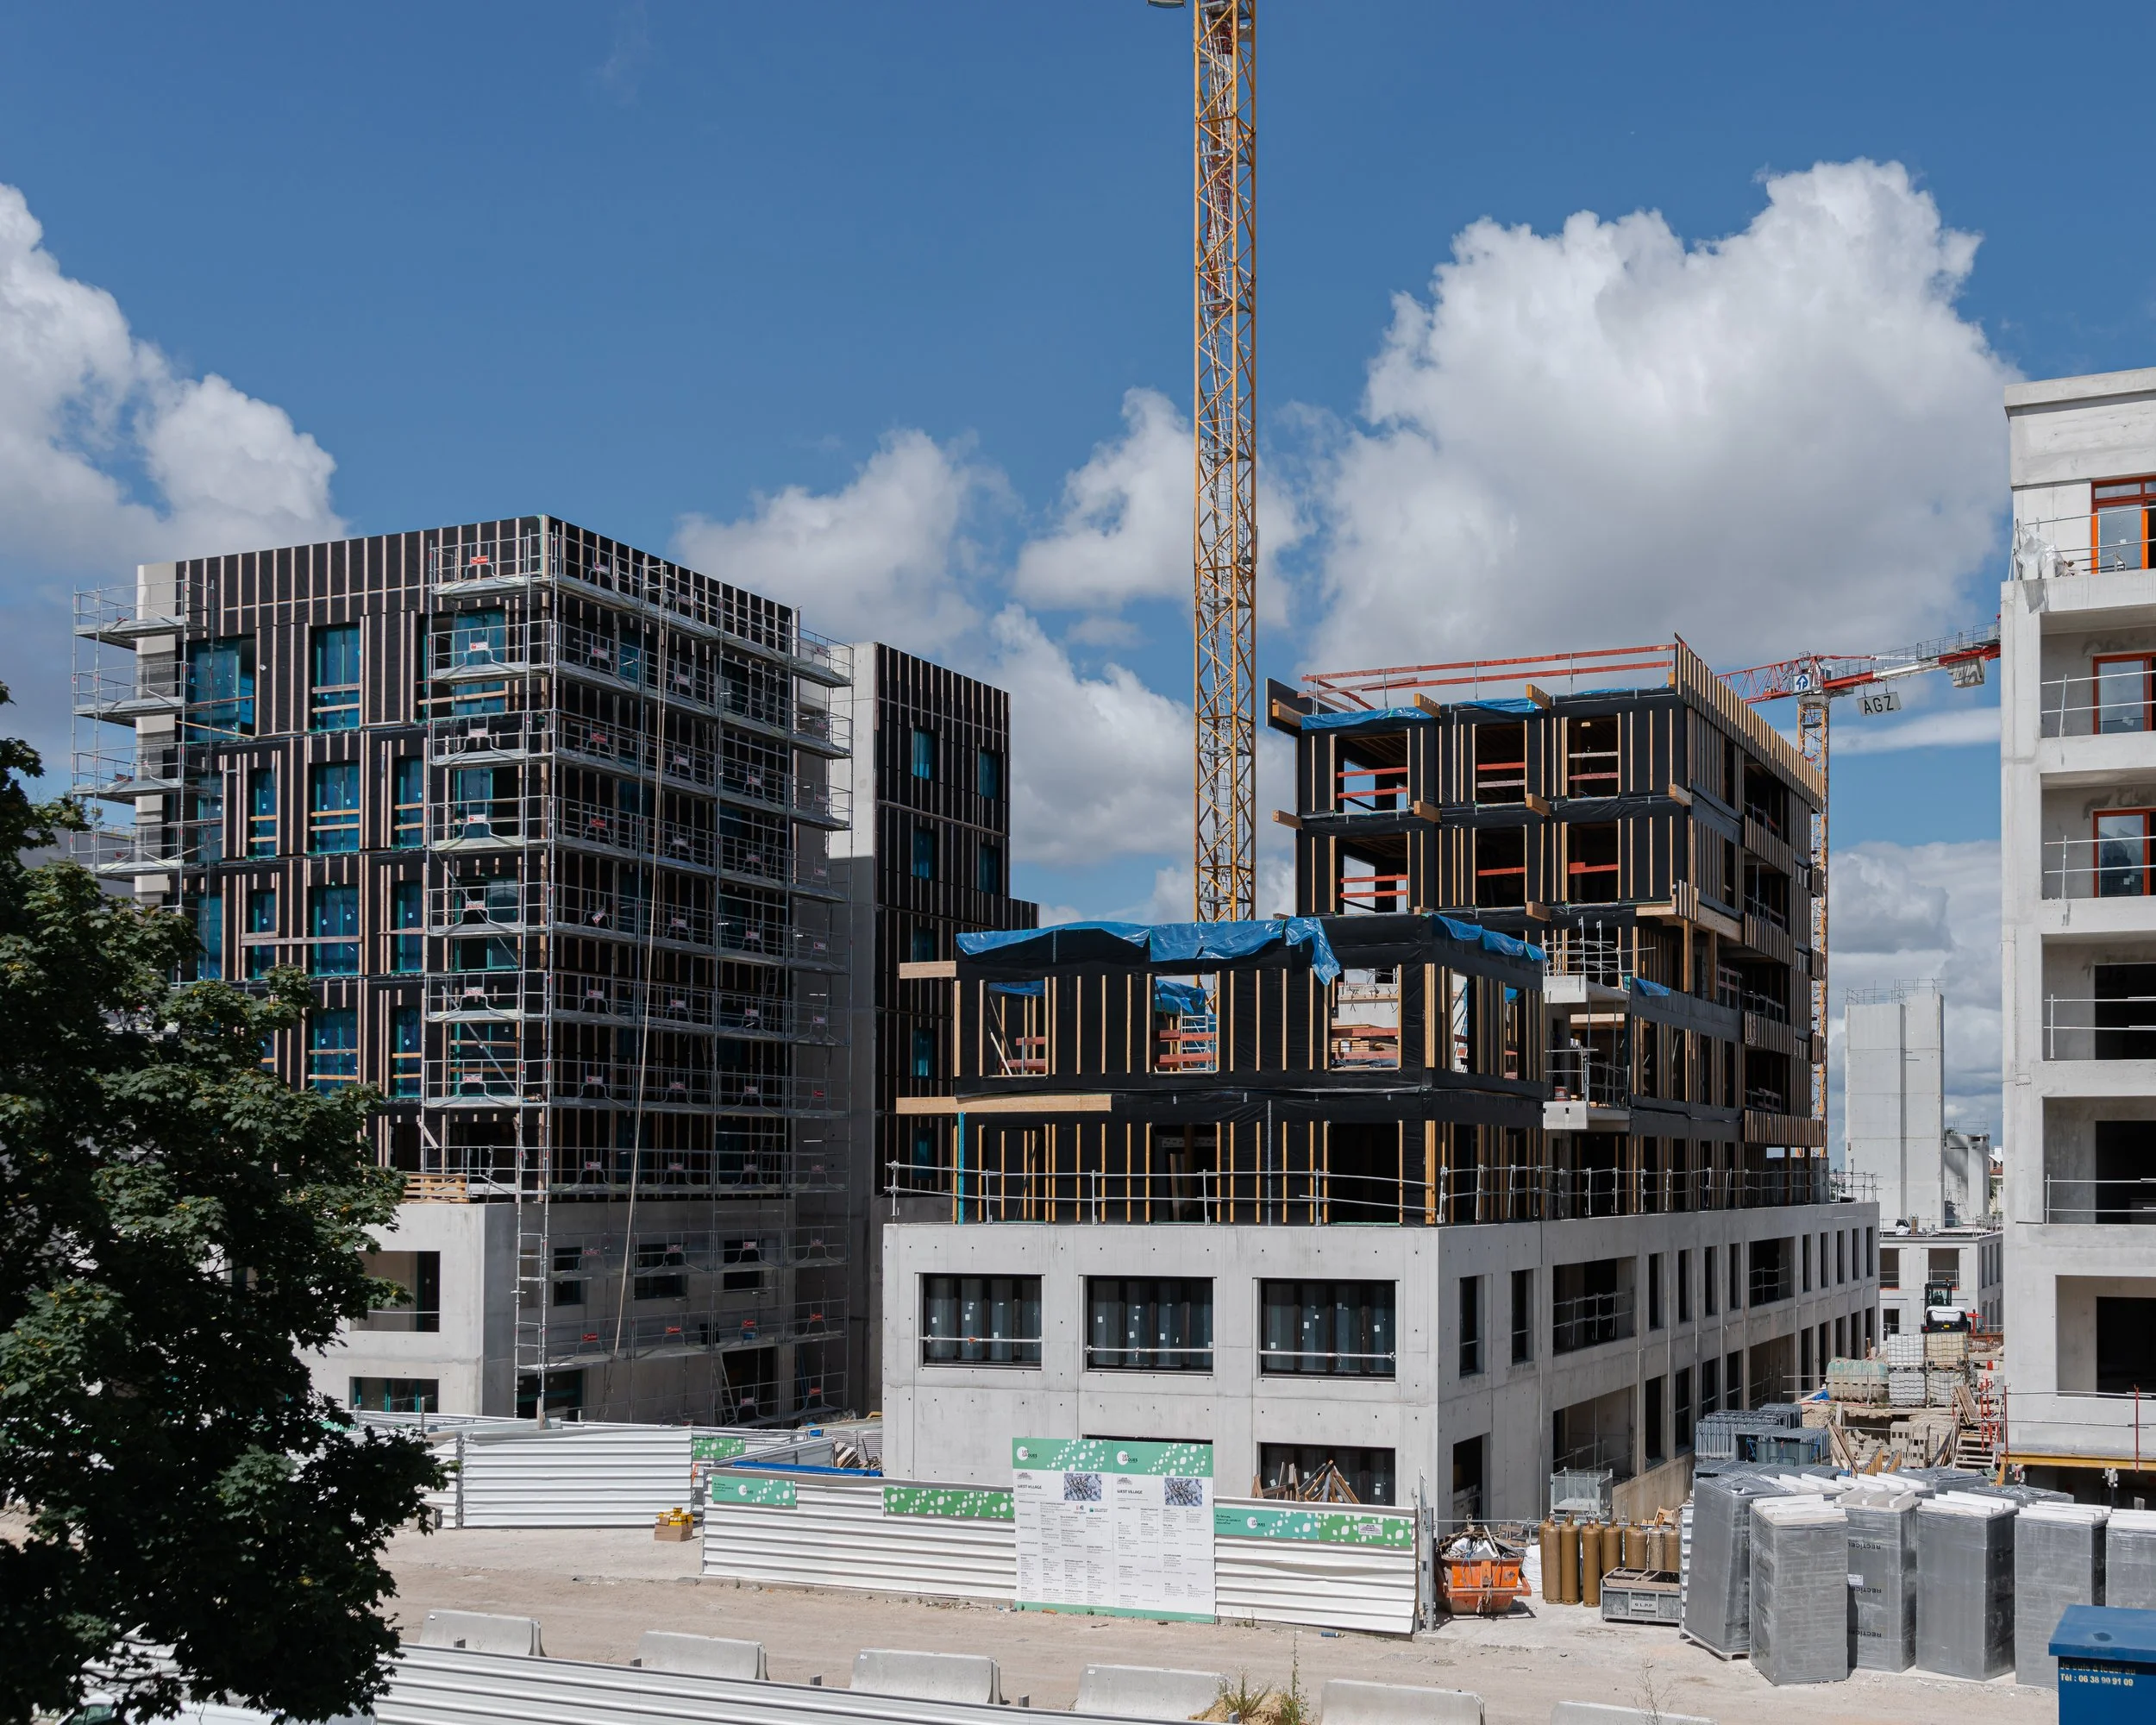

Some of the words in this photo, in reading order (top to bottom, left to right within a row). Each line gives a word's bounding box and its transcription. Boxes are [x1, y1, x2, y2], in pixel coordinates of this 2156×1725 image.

[1864, 695, 1894, 714] AGZ
[2060, 1673, 2072, 1682] Tél
[2090, 1675, 2099, 1684] 38
[2101, 1676, 2110, 1684] 90
[2112, 1677, 2122, 1685] 91
